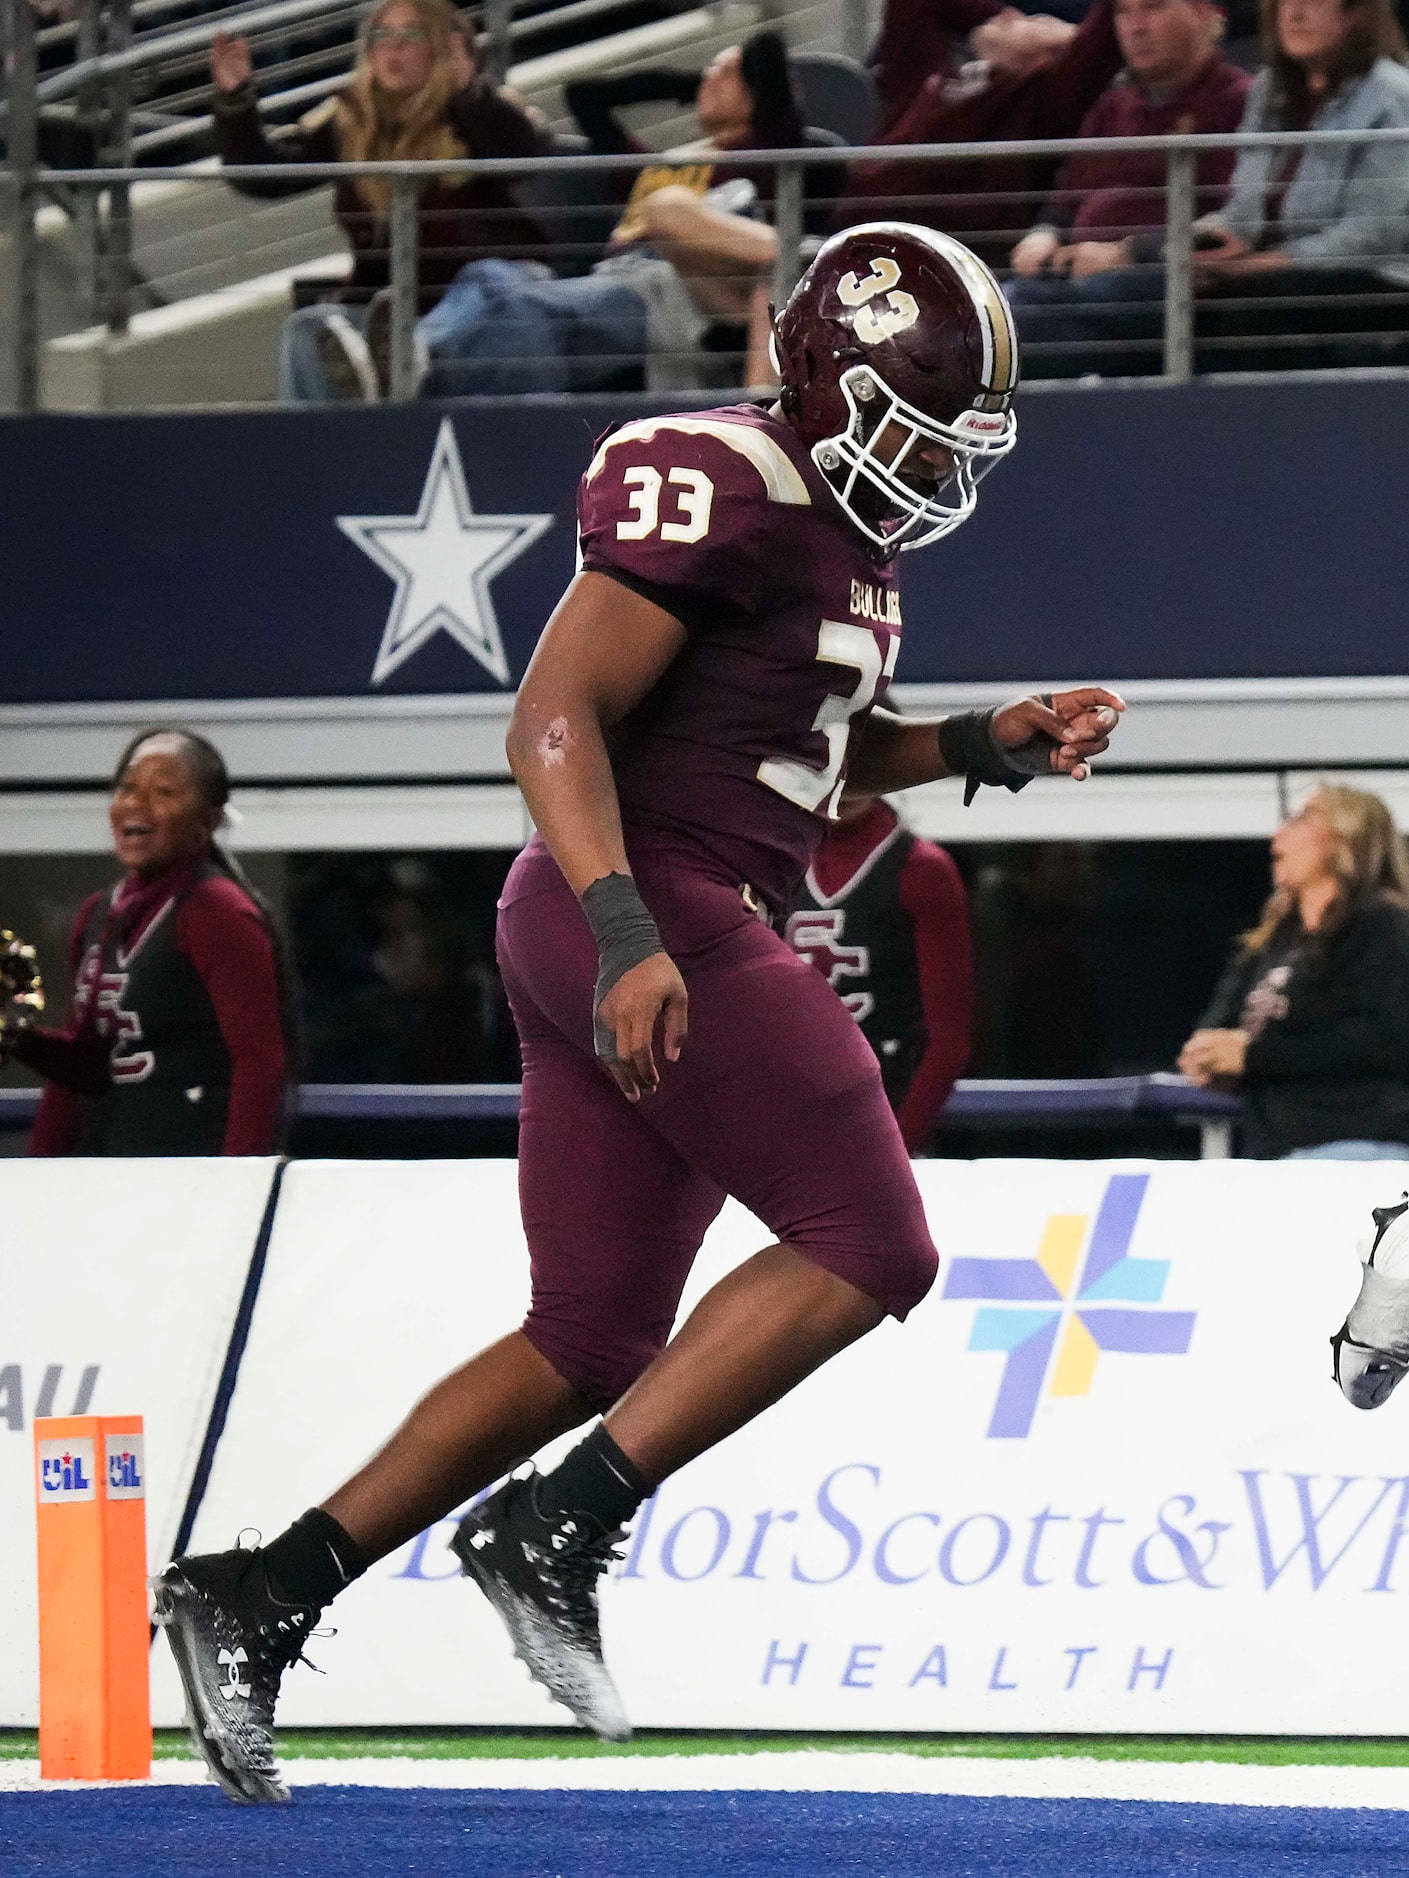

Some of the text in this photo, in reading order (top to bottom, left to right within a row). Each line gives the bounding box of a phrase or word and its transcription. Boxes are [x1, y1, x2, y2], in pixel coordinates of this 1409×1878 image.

[836, 256, 920, 345] 33
[616, 465, 715, 544] 33
[760, 1640, 1175, 1692] HEALTH
